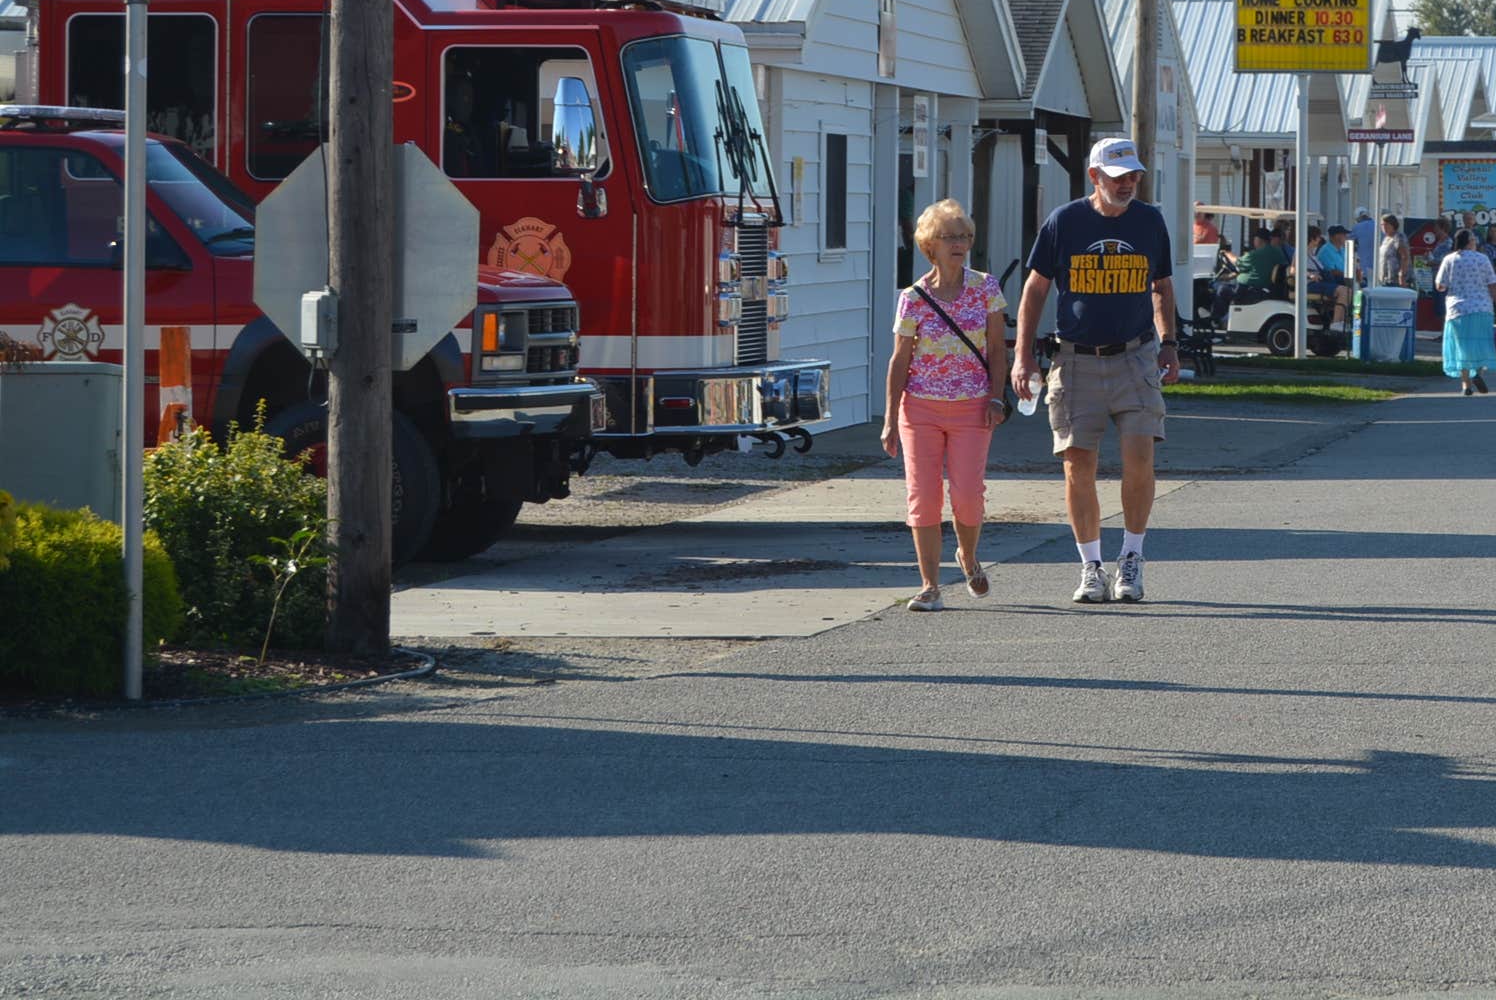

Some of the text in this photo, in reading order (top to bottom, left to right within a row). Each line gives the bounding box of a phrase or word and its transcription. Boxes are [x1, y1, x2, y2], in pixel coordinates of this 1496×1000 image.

[1255, 10, 1305, 25] DINNER
[1349, 132, 1413, 140] GERANIUM LANE
[1457, 174, 1488, 183] Valley
[1070, 254, 1149, 269] WEST VIRGINIA
[1069, 269, 1149, 294] BASKETBALL
